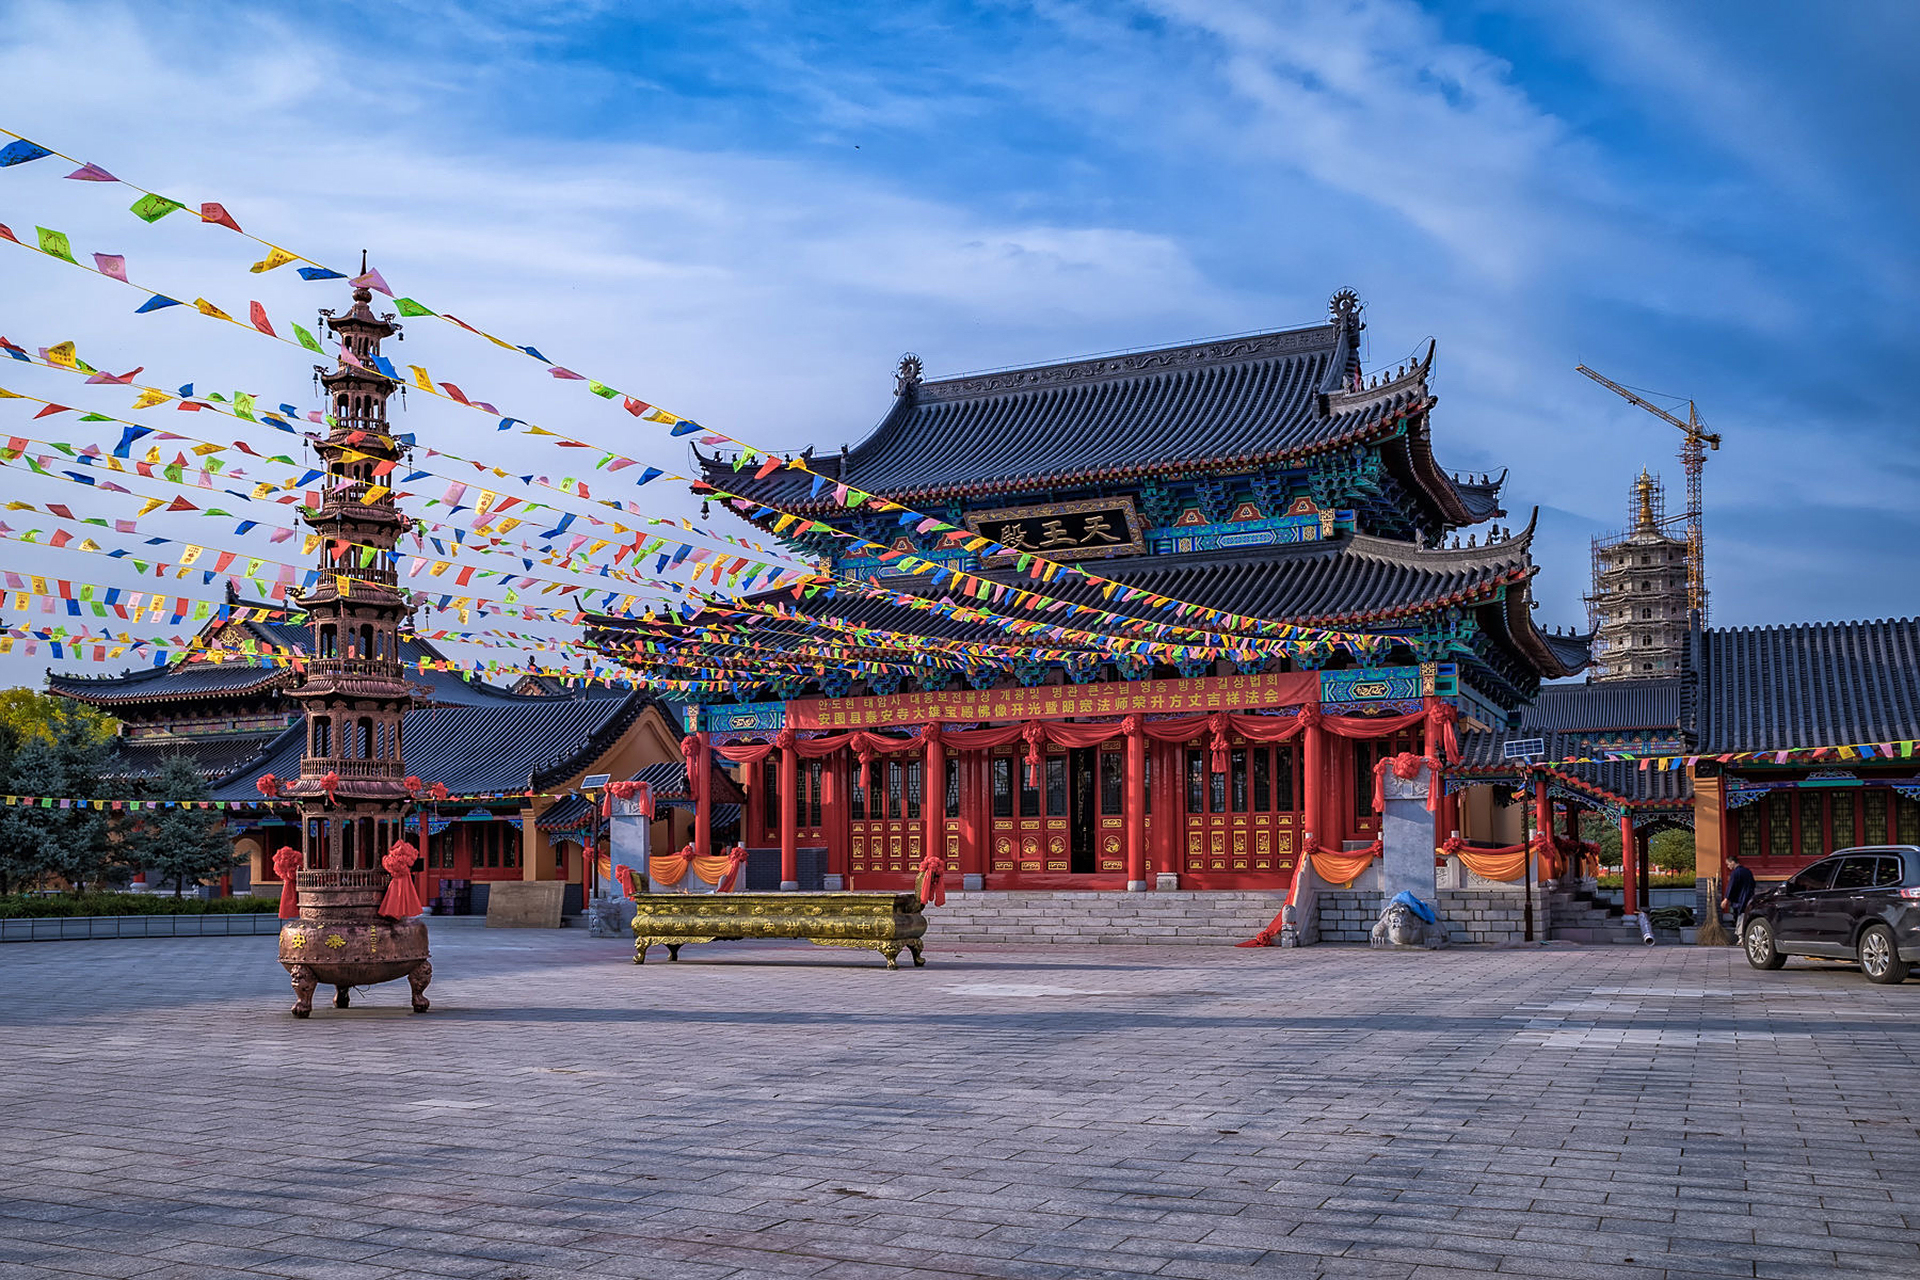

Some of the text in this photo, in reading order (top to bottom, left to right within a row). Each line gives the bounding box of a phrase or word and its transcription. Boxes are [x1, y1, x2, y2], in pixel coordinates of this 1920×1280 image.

[1000, 515, 1118, 549] 天王殿
[818, 699, 854, 711] 안도현
[1087, 683, 1130, 697] 큰스님
[1140, 681, 1168, 693] 영승
[1178, 678, 1206, 692] 방장
[1217, 674, 1278, 690] 길상법회
